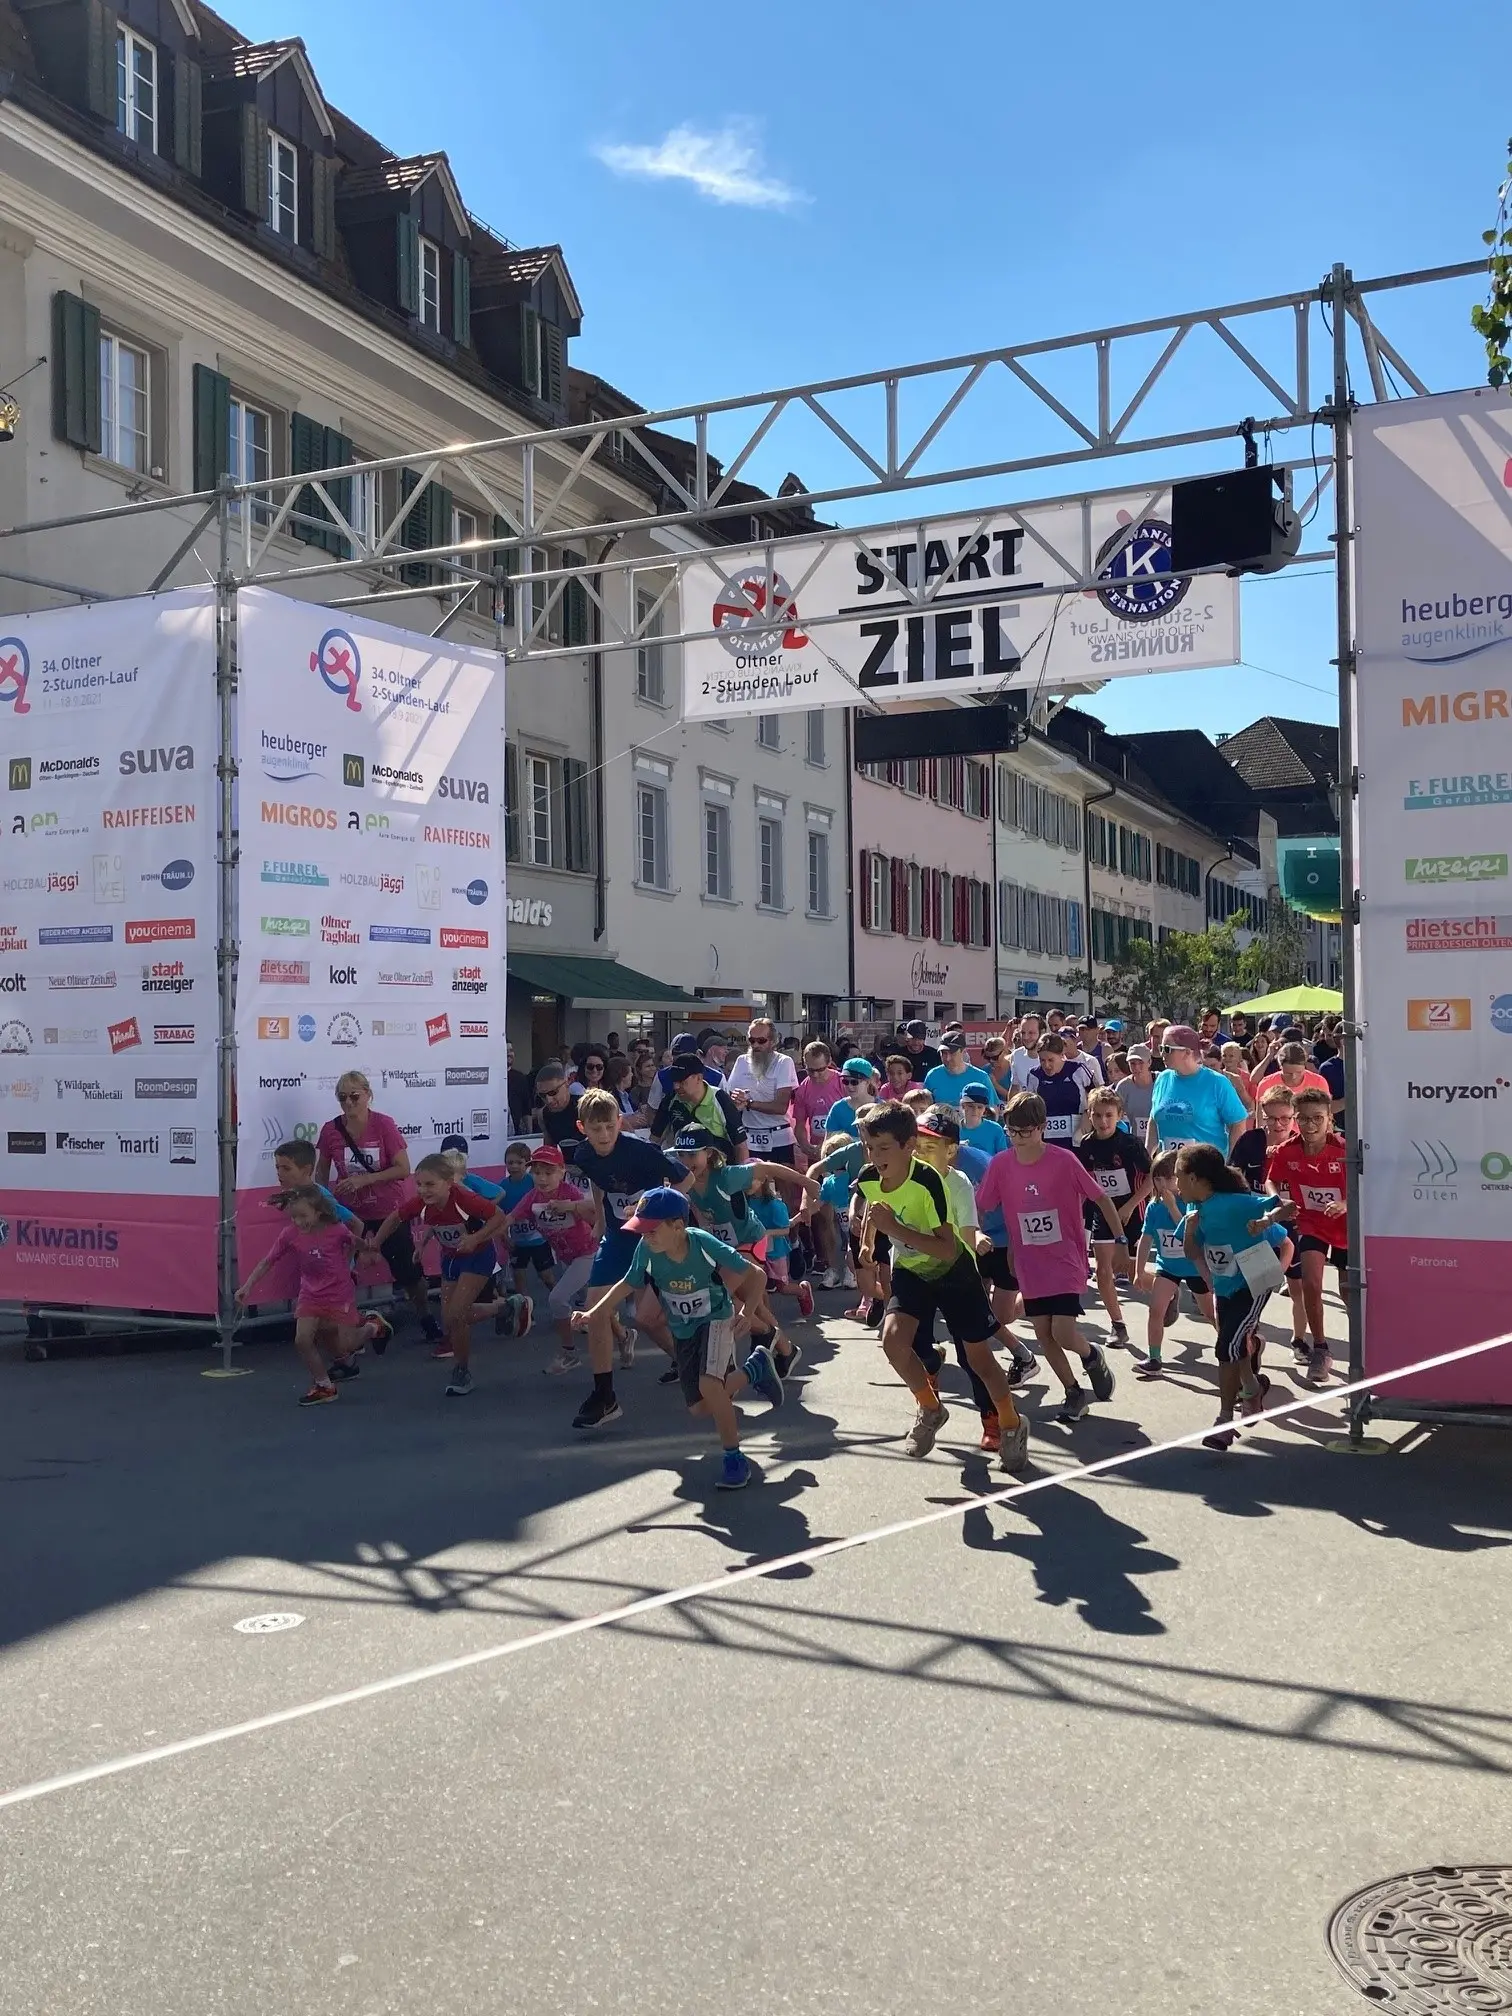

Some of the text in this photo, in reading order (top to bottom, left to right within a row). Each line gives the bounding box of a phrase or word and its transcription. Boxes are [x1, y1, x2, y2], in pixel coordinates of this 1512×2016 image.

[856, 528, 1024, 595] START
[1088, 624, 1205, 646] KIWANIS CLUB OLTEN
[1402, 620, 1504, 647] augenklinik
[858, 606, 1022, 688] ZIEL
[42, 656, 102, 673] 34. Oltner
[735, 654, 783, 669] Oltner
[42, 667, 139, 692] 2-Stunden-Lauf
[372, 667, 422, 689] 34. Oltner
[702, 670, 819, 695] 2-Stunden Lauf
[372, 685, 450, 714] 2-Stunden-Lauf
[1402, 689, 1512, 727] MIGR
[261, 730, 327, 760] heuberger
[40, 756, 100, 773] McDonald's
[119, 745, 195, 775] suva
[261, 753, 311, 771] augenklinik
[372, 764, 424, 784] McDonald's
[438, 775, 490, 804] suva
[1409, 780, 1424, 796] F.
[102, 804, 195, 829] RAIFFEISEN
[261, 801, 337, 830] MIGROS
[424, 825, 490, 849] RAIFFEISEN
[263, 860, 319, 878] F. FURRER
[321, 915, 352, 929] Oltner
[1406, 916, 1496, 938] dietschi
[129, 923, 191, 940] youcinema
[320, 929, 360, 945] Tagblatt
[443, 932, 487, 946] youcinema
[1407, 939, 1479, 950] PRINT&DESIGN
[152, 961, 184, 976] stadt
[261, 960, 303, 974] dietschi
[330, 965, 357, 985] kolt
[459, 966, 481, 980] stadt
[49, 974, 116, 986] Neue Oltner Zeitung
[142, 976, 194, 993] anzeiger
[452, 978, 487, 994] anzeiger
[154, 1030, 195, 1040] STRABAG
[460, 1025, 488, 1034] STRABAG
[260, 1076, 300, 1090] horyzon
[388, 1070, 419, 1080] Wildpark
[405, 1078, 436, 1088] Mühletäli
[447, 1070, 488, 1081] RoomDesign
[64, 1080, 100, 1091] Wildpark
[137, 1081, 196, 1094] RoomDesign
[1408, 1081, 1498, 1103] horyzon
[84, 1090, 123, 1100] Mühletäli
[397, 1124, 422, 1135] scher
[434, 1118, 464, 1135] marti
[69, 1137, 105, 1150] fischer
[120, 1135, 159, 1153] marti
[750, 1133, 769, 1145] 165
[350, 1153, 374, 1166] 40
[1308, 1191, 1335, 1205] 423
[1413, 1188, 1458, 1201] Olten
[1024, 1215, 1053, 1234] 125
[16, 1220, 119, 1252] Kiwanis
[16, 1251, 120, 1269] KIWANIS CLUB OLTEN
[1410, 1256, 1458, 1268] Patronat
